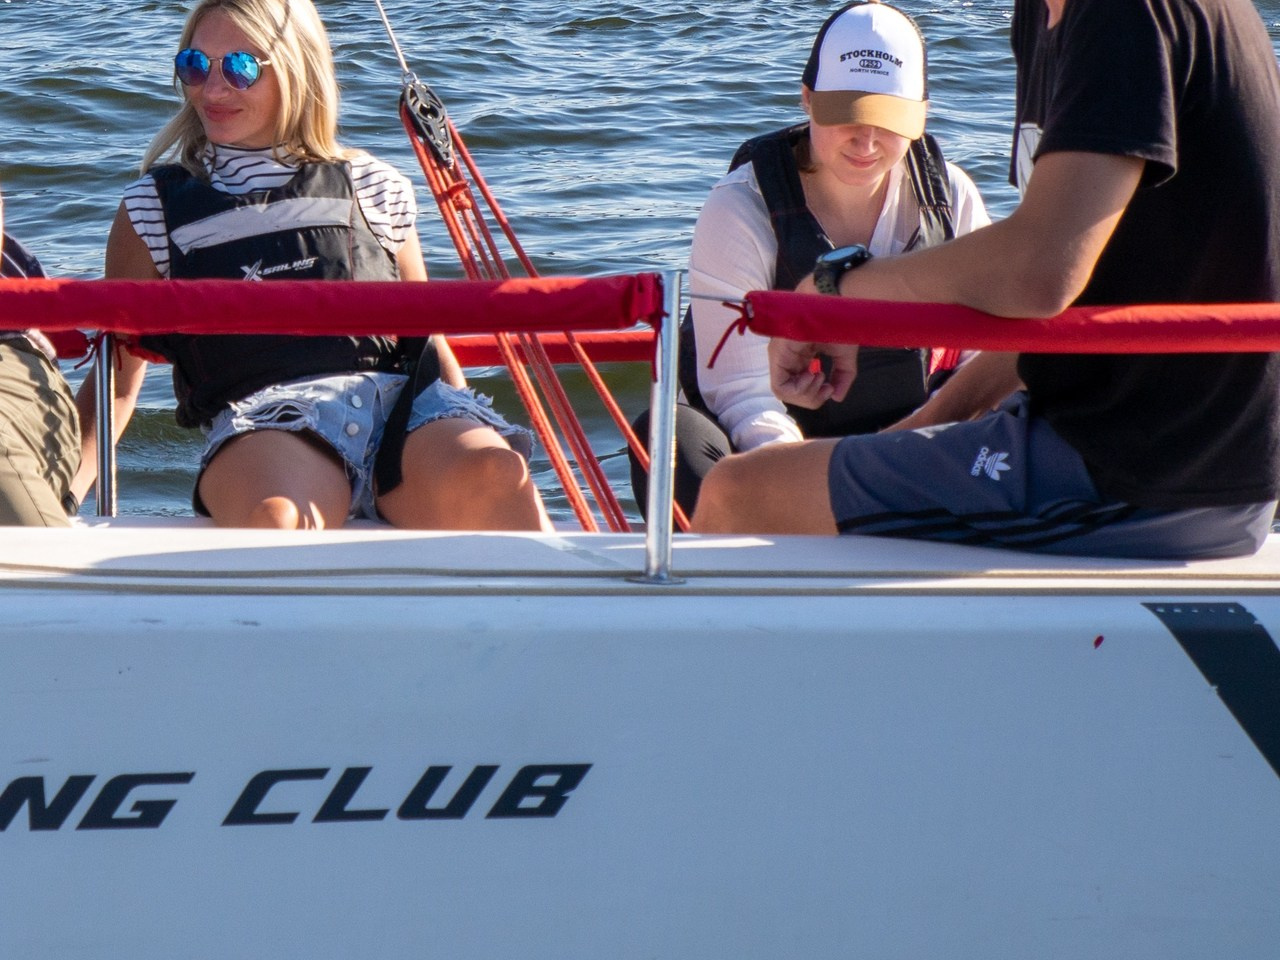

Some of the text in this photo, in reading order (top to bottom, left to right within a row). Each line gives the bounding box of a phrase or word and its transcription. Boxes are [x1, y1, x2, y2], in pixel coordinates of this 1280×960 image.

[839, 50, 903, 68] STOCKHOLM
[970, 446, 990, 477] adidas
[223, 764, 592, 826] CLUB
